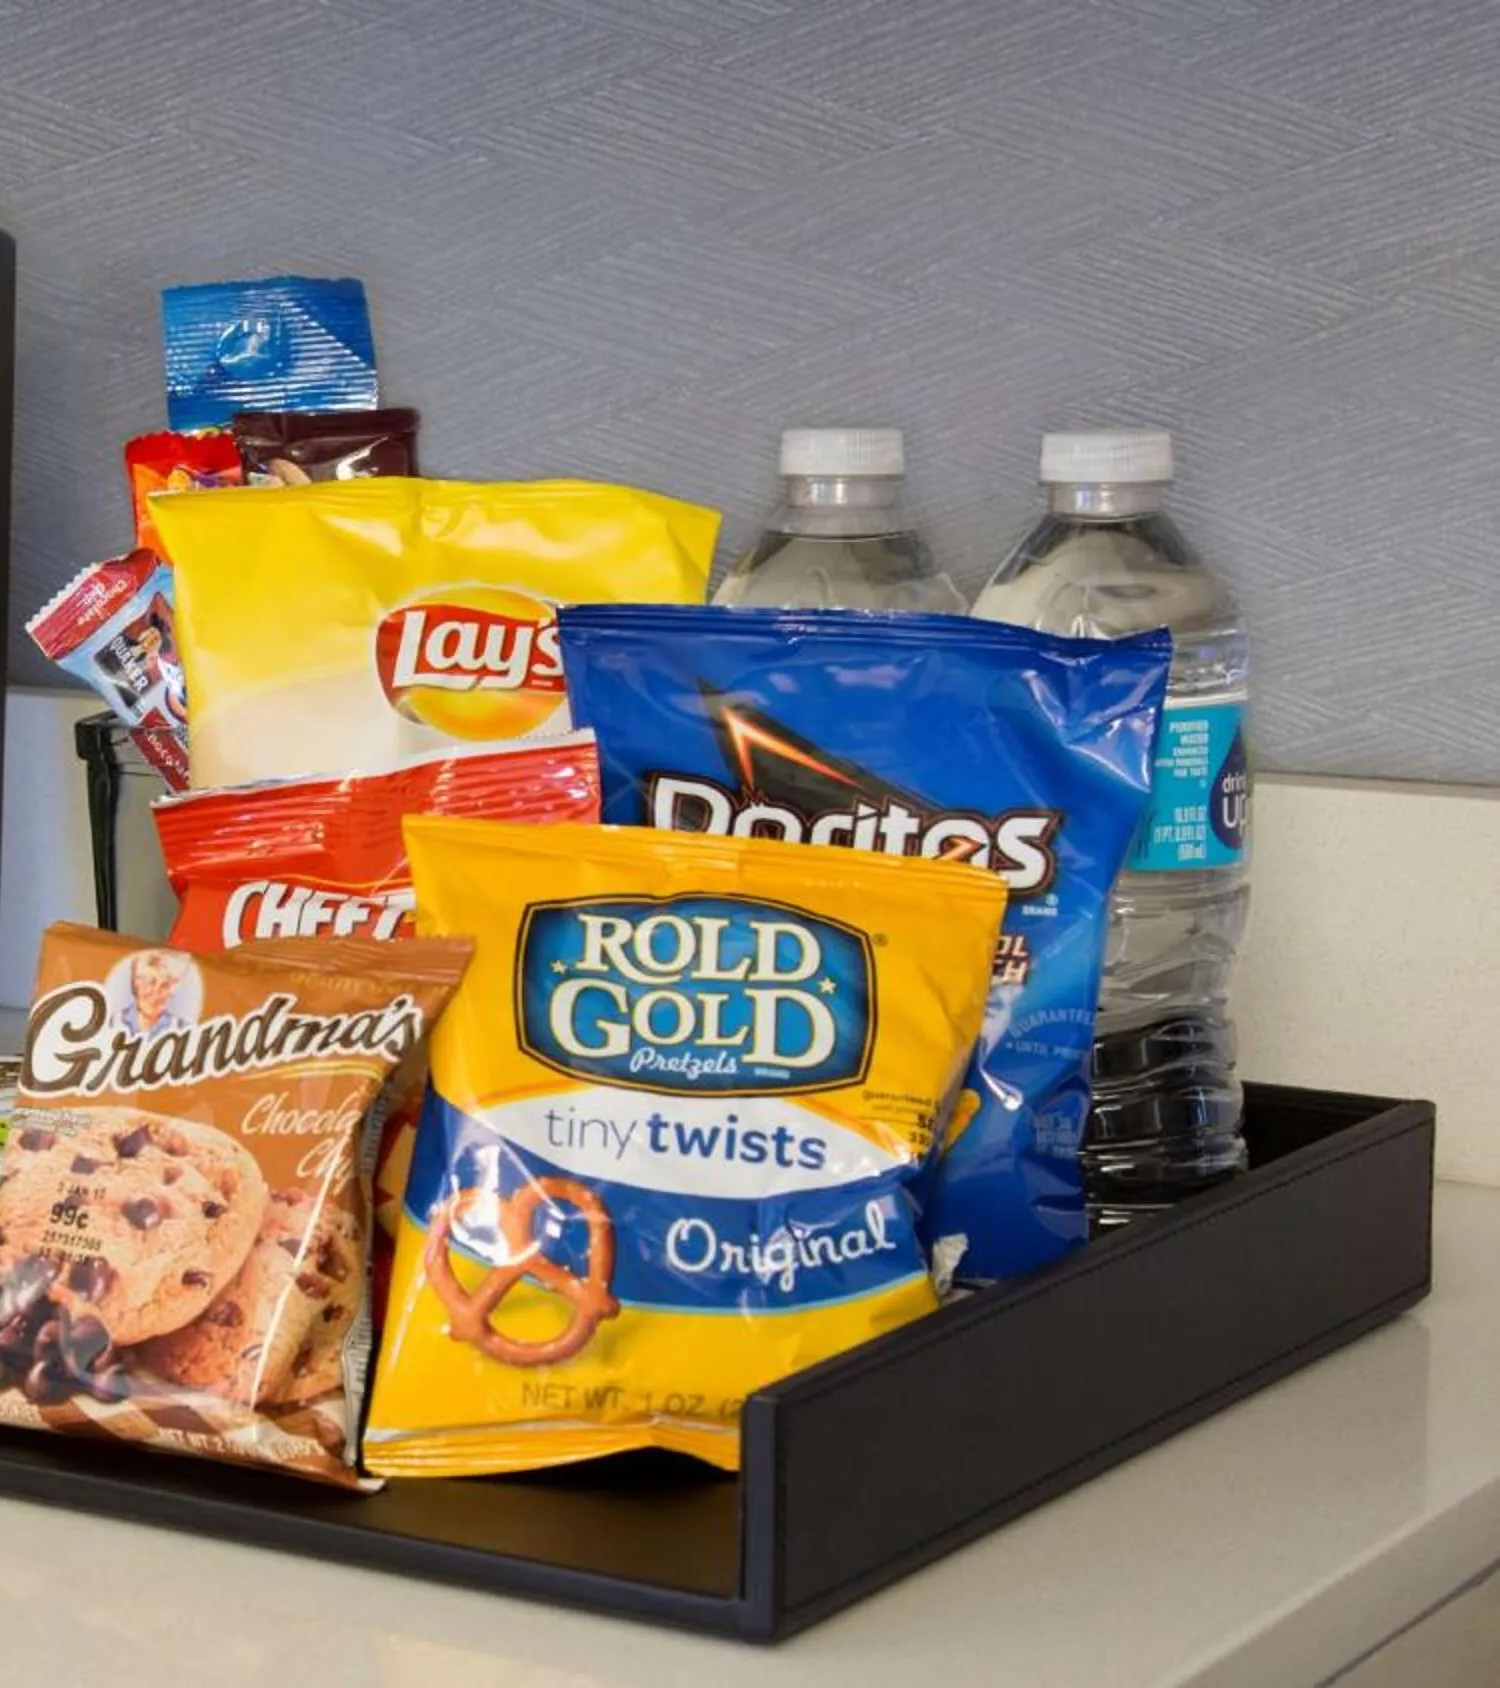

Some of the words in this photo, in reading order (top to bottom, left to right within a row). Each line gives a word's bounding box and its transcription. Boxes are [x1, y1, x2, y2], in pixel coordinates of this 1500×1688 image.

[110, 635, 149, 692] QUAKER
[654, 777, 1050, 889] Doritos
[222, 880, 417, 950] CHEET
[573, 911, 822, 984] ROLD
[19, 983, 426, 1098] Grandma's
[549, 979, 838, 1069] GOLD
[628, 1046, 738, 1081] Pretzels
[545, 1106, 638, 1161] tiny
[647, 1111, 828, 1172] twists
[664, 1202, 897, 1293] Original
[521, 1382, 576, 1409] NET
[663, 1392, 707, 1416] OZ
